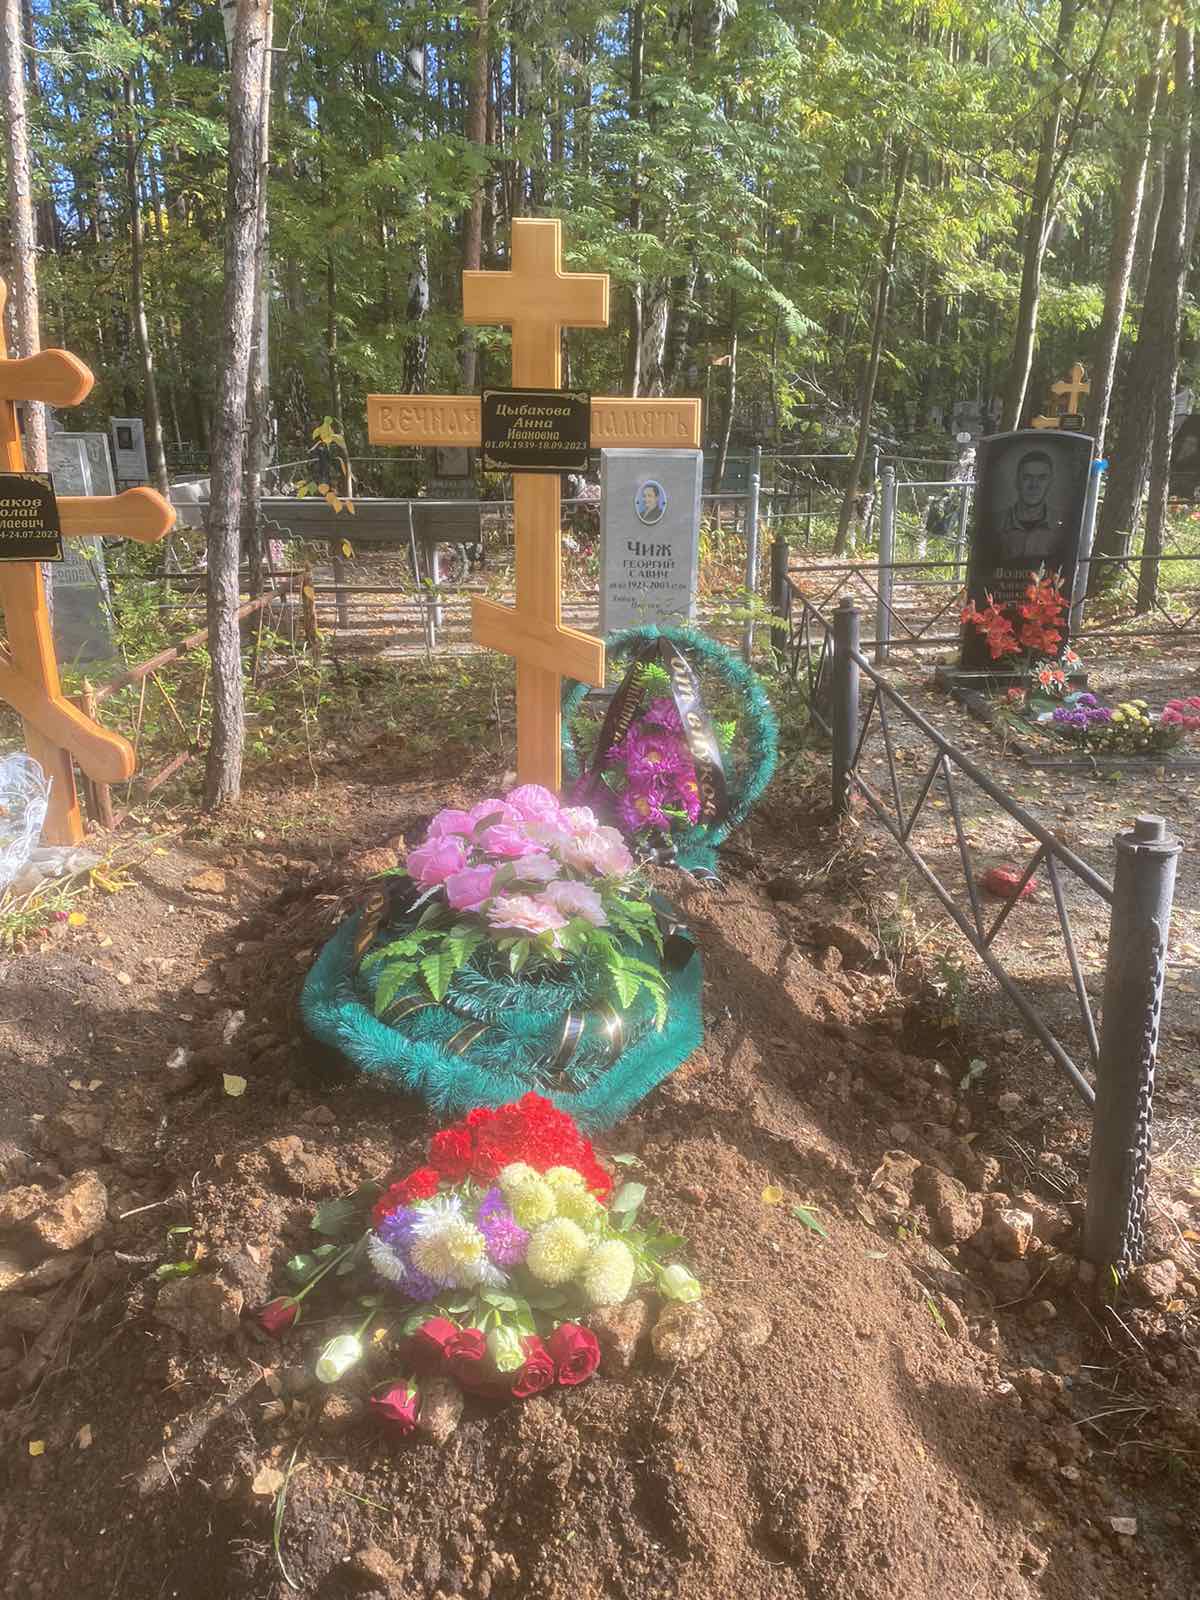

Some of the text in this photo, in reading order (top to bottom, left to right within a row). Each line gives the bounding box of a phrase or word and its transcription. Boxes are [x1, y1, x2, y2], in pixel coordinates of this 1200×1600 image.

[496, 404, 571, 416] Цыбакова
[513, 417, 553, 428] Анна
[507, 428, 560, 440] Ивановна
[627, 541, 672, 556] ЧИЖ
[623, 558, 676, 568] ГЕОРГИЙ
